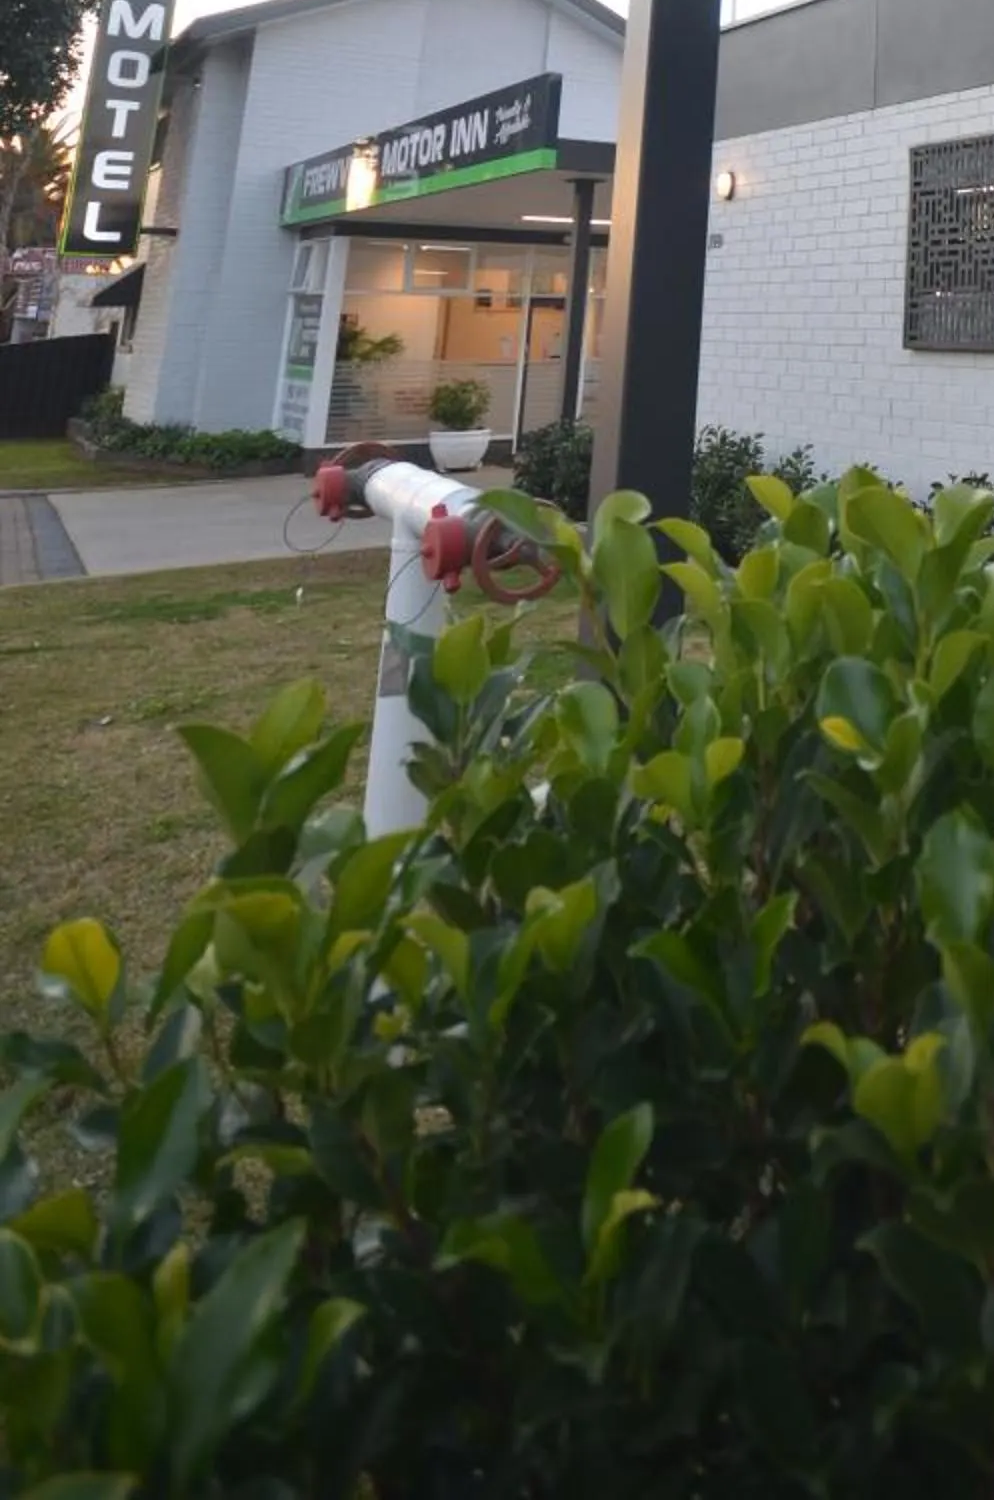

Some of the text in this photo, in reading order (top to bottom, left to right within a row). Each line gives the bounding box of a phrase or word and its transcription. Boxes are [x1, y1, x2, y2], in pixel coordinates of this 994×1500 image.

[83, 0, 165, 242] MOTEL
[303, 145, 380, 197] FREWV
[382, 123, 446, 177] MOTOR
[449, 109, 489, 158] INN
